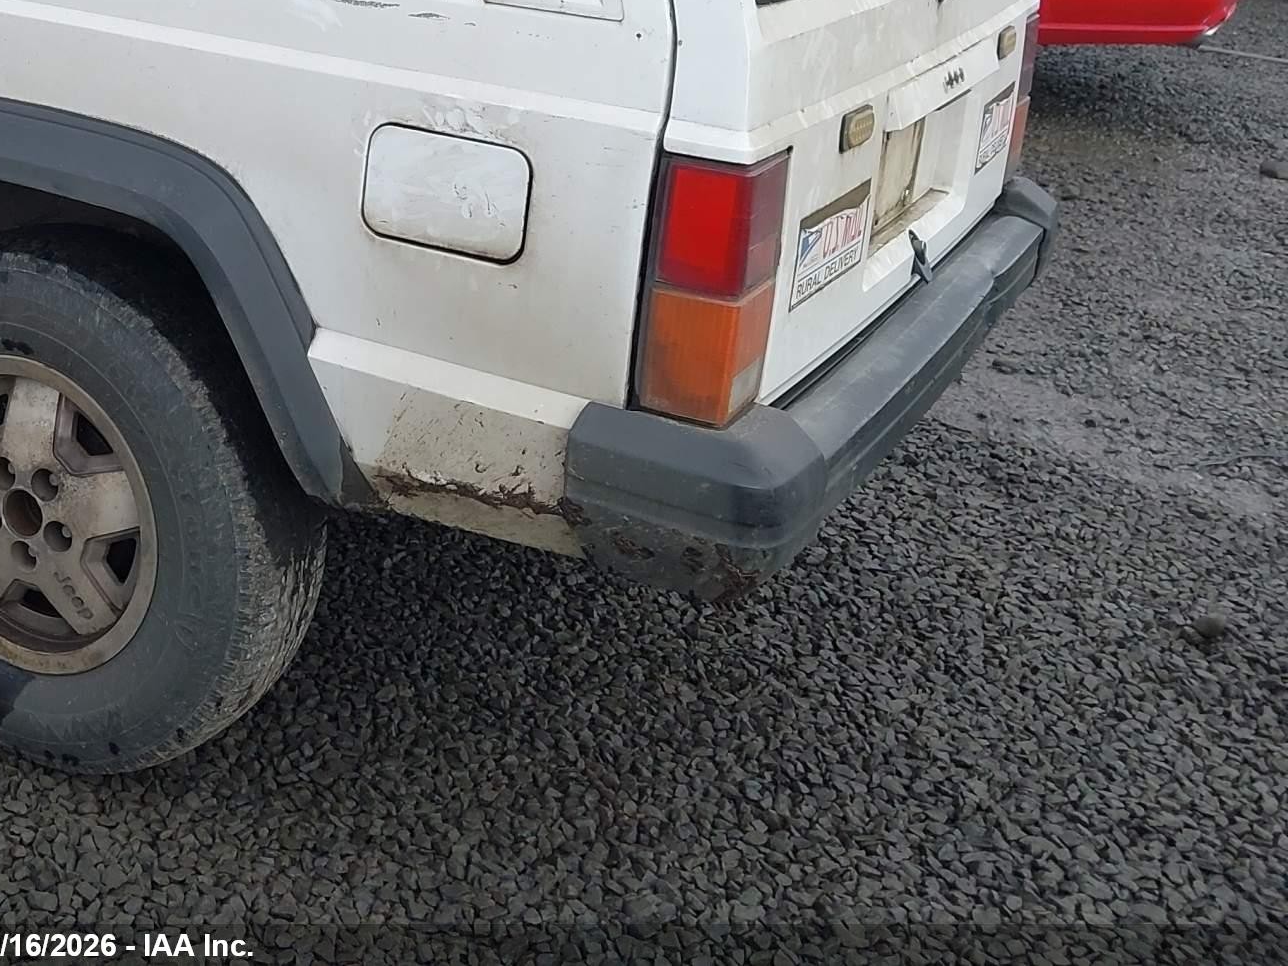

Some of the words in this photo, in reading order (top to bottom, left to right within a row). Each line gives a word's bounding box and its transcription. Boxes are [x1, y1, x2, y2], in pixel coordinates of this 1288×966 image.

[796, 273, 821, 299] RURAL
[824, 247, 858, 280] DELIVERY
[53, 571, 94, 620] Jeep
